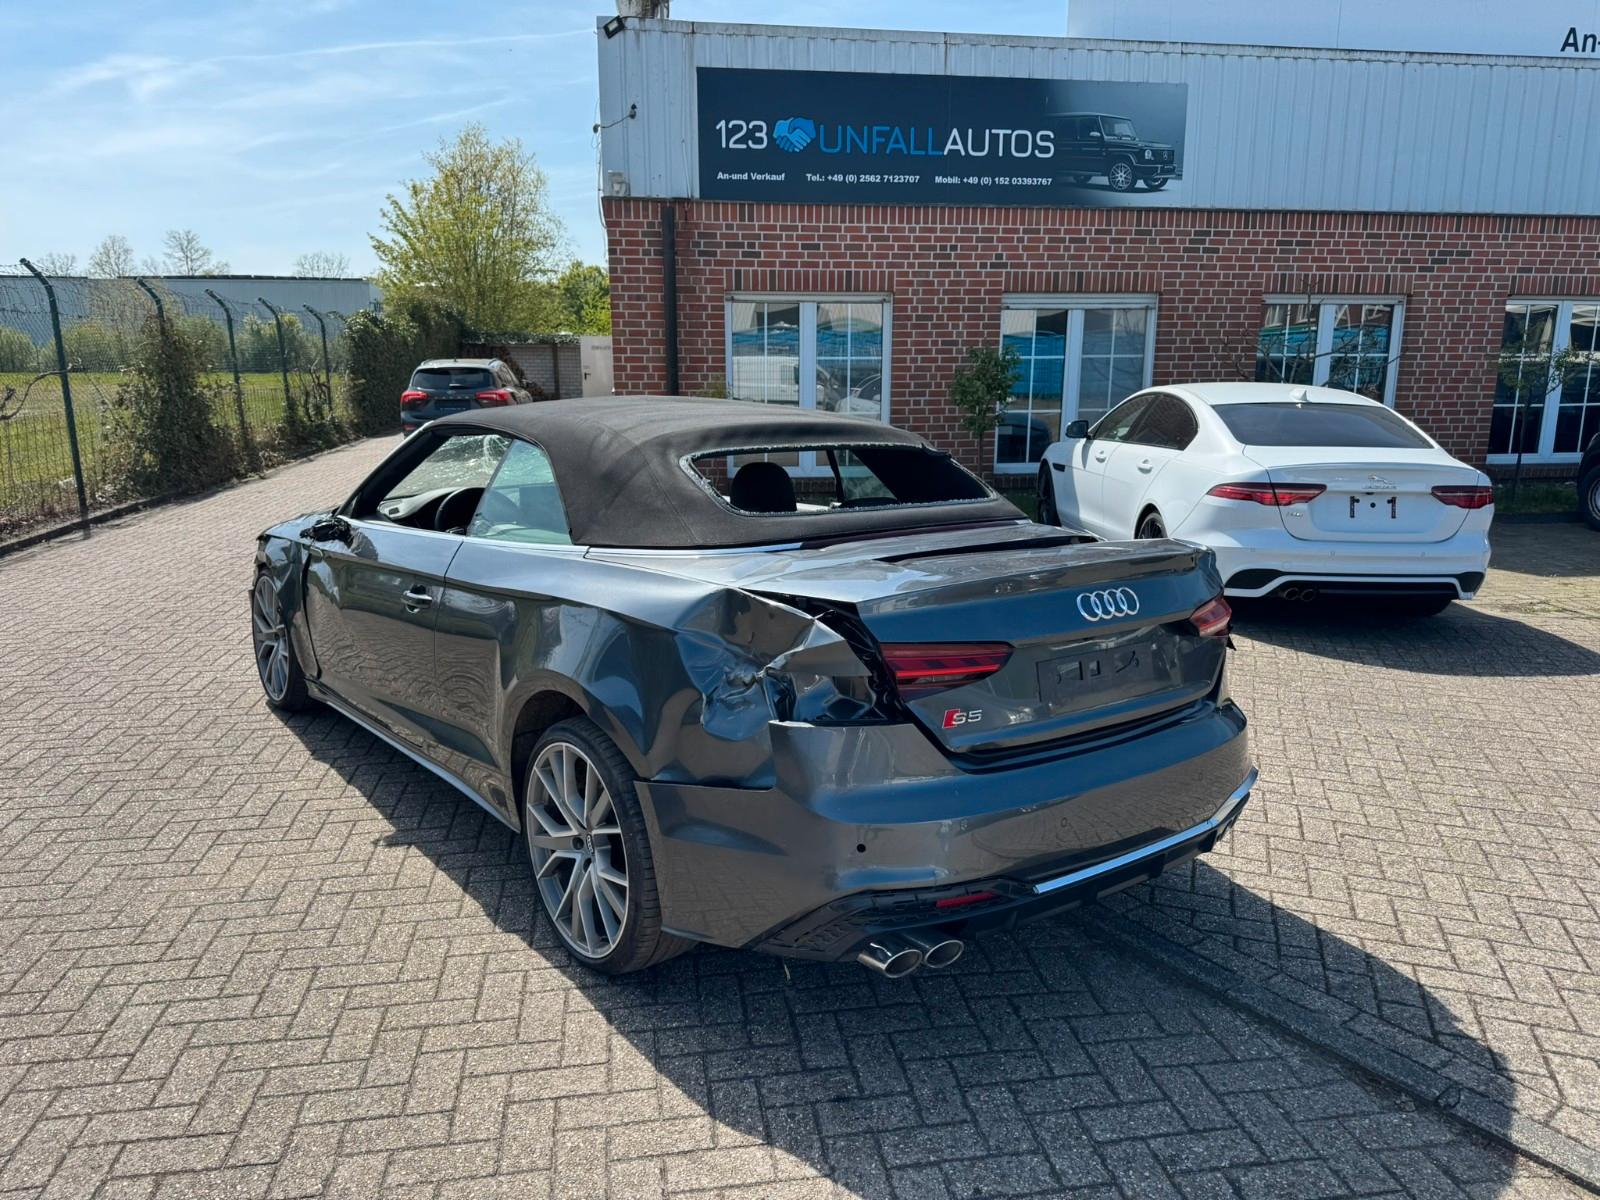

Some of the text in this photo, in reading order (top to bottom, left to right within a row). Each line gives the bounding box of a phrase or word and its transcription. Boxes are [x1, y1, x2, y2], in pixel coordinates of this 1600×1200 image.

[715, 119, 768, 150] 123
[716, 171, 786, 181] An-und Verkauf
[827, 174, 843, 182] +49
[845, 174, 858, 184] (0)
[859, 174, 881, 183] 2562
[883, 175, 920, 183] 7123707
[934, 176, 1053, 186] Mobil: +49 (0) 152 03393767
[951, 709, 983, 725] S5
